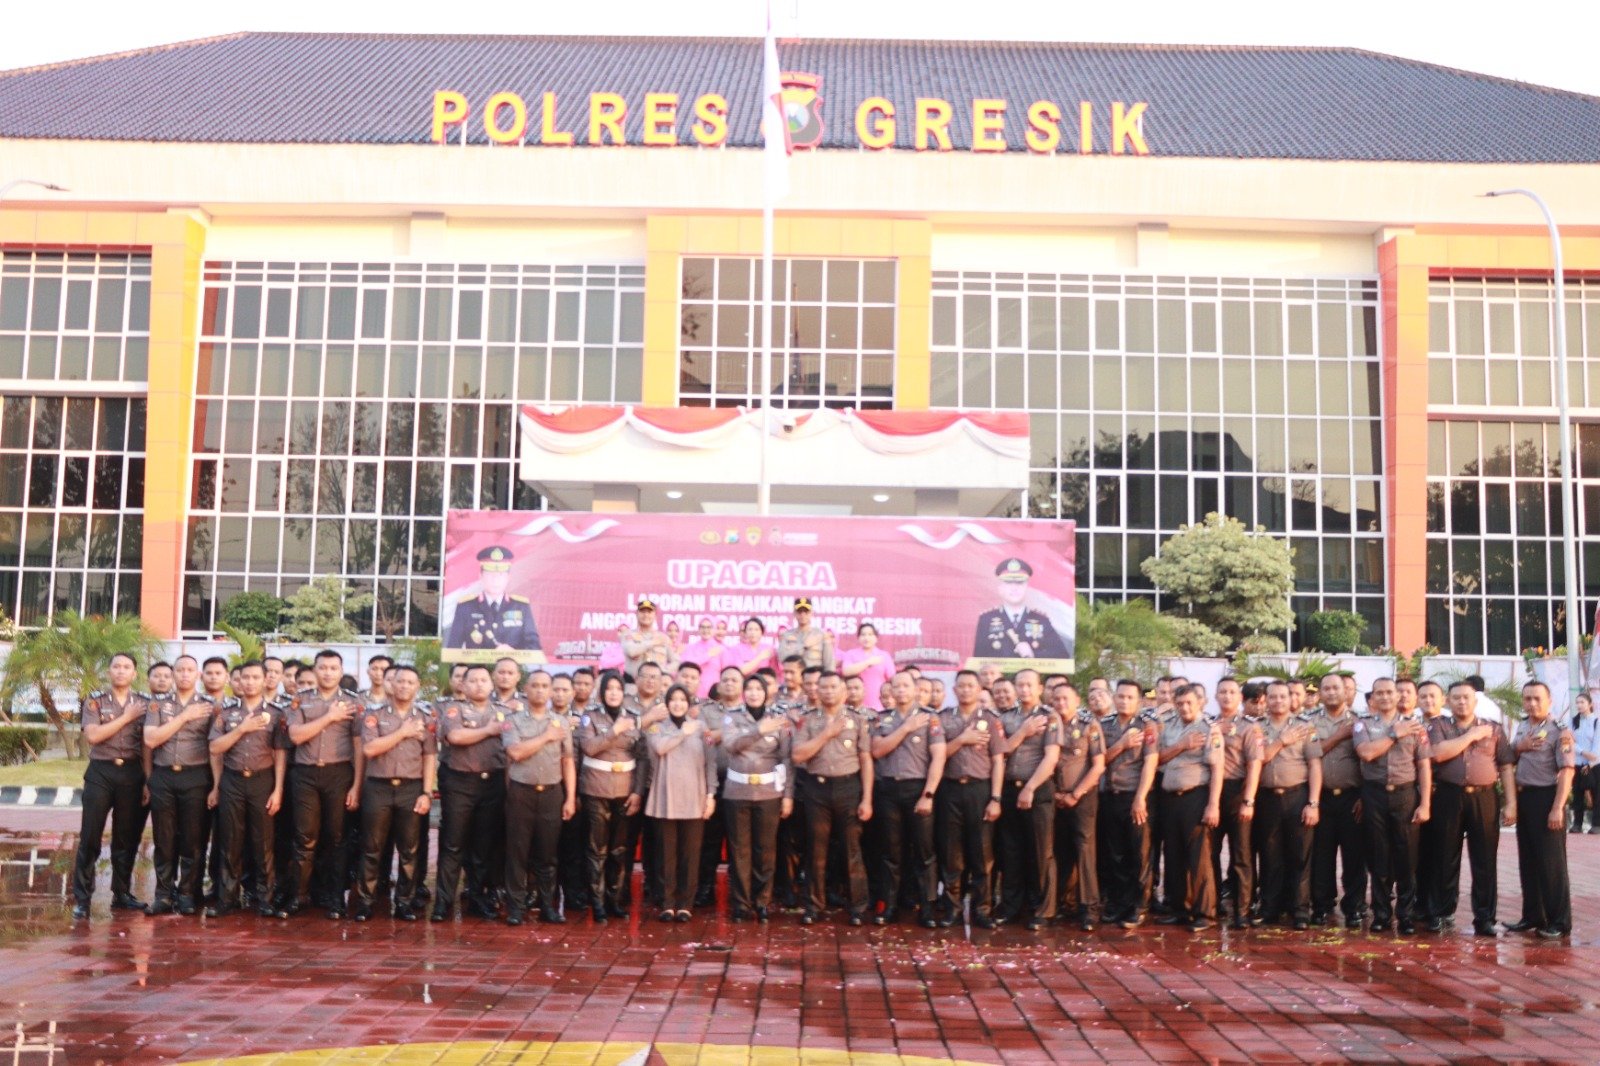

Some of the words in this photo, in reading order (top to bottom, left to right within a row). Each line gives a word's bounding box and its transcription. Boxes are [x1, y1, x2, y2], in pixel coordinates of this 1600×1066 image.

[431, 90, 729, 147] POLRES
[854, 96, 1149, 156] GRESIK
[667, 559, 838, 591] UPACARA
[709, 595, 794, 613] KENAIKAN
[811, 596, 876, 615] ANGKAT
[580, 612, 659, 631] ANGGO
